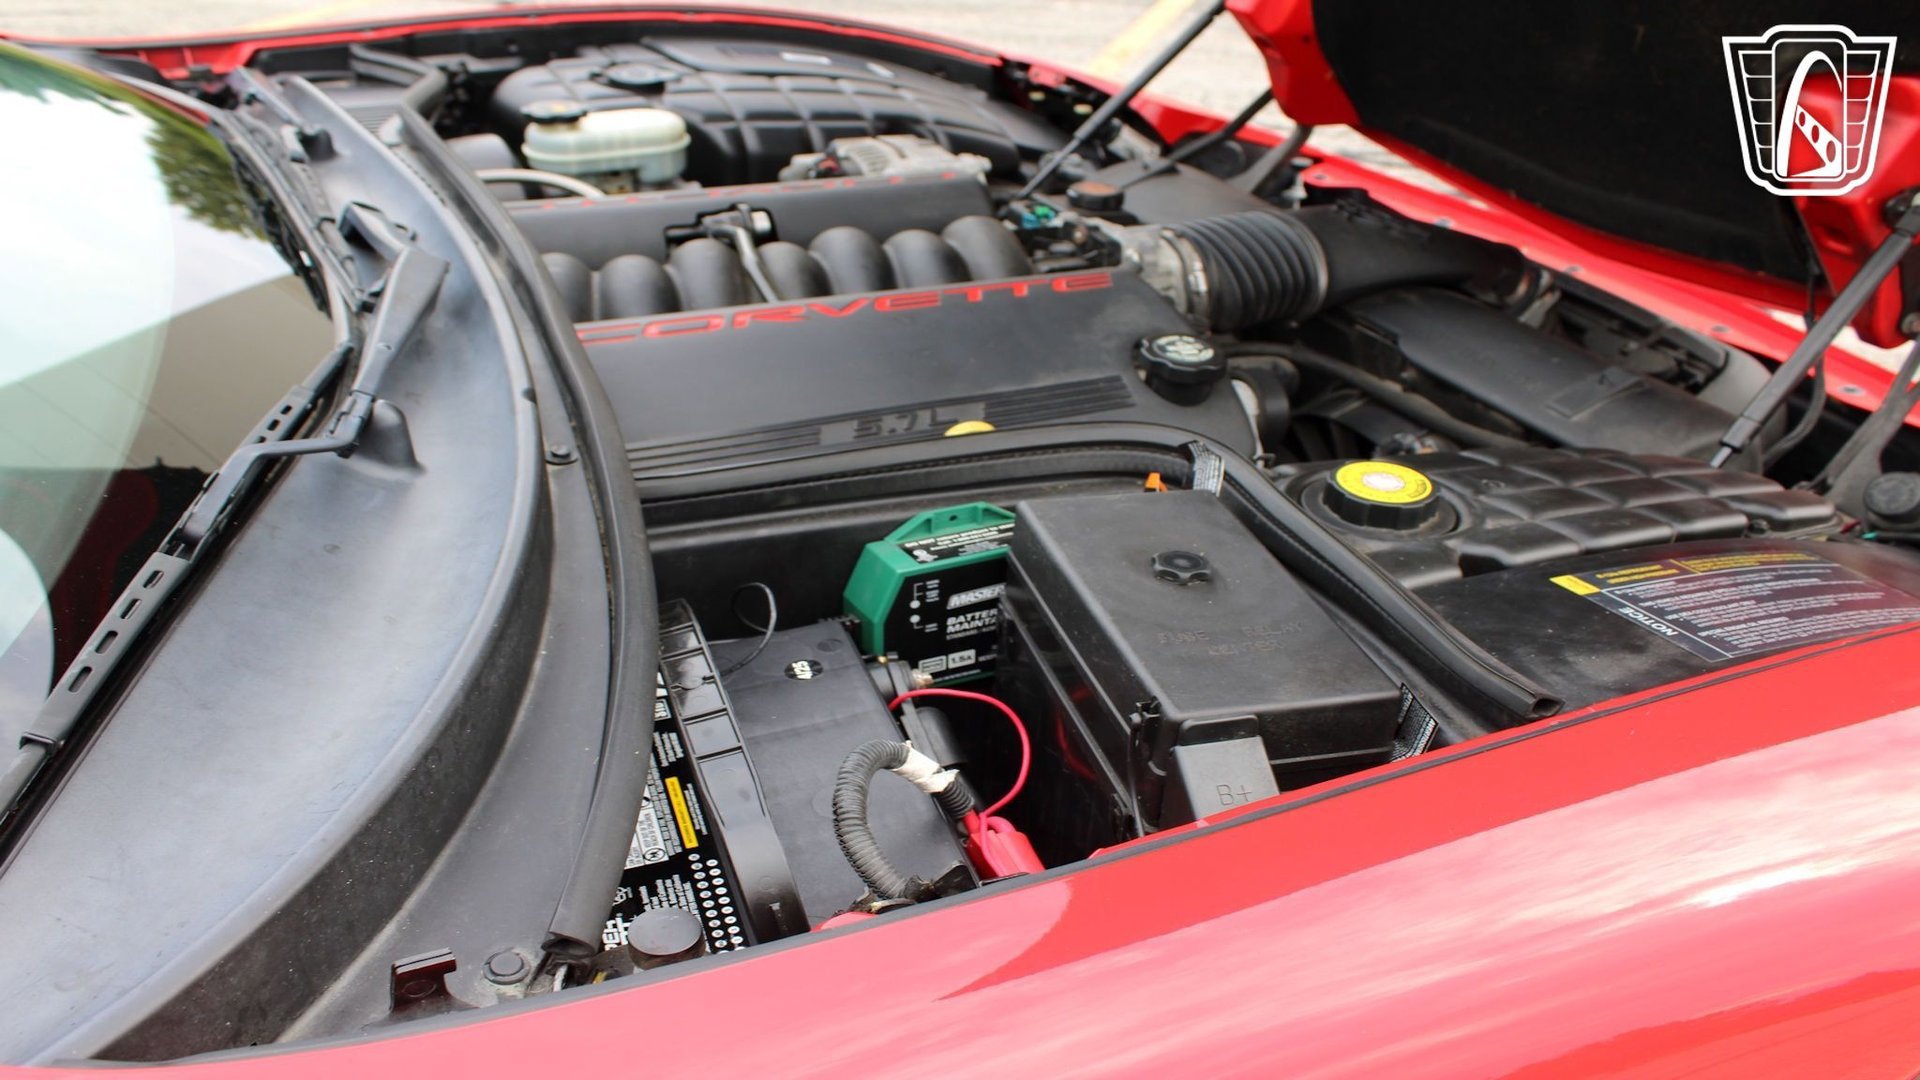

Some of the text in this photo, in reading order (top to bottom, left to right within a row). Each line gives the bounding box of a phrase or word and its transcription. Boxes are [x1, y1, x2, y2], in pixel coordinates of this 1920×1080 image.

[576, 272, 1111, 347] CORVETTE
[853, 407, 958, 439] 5.7L
[1618, 606, 1679, 636] NOTICE
[1216, 784, 1252, 806] B+
